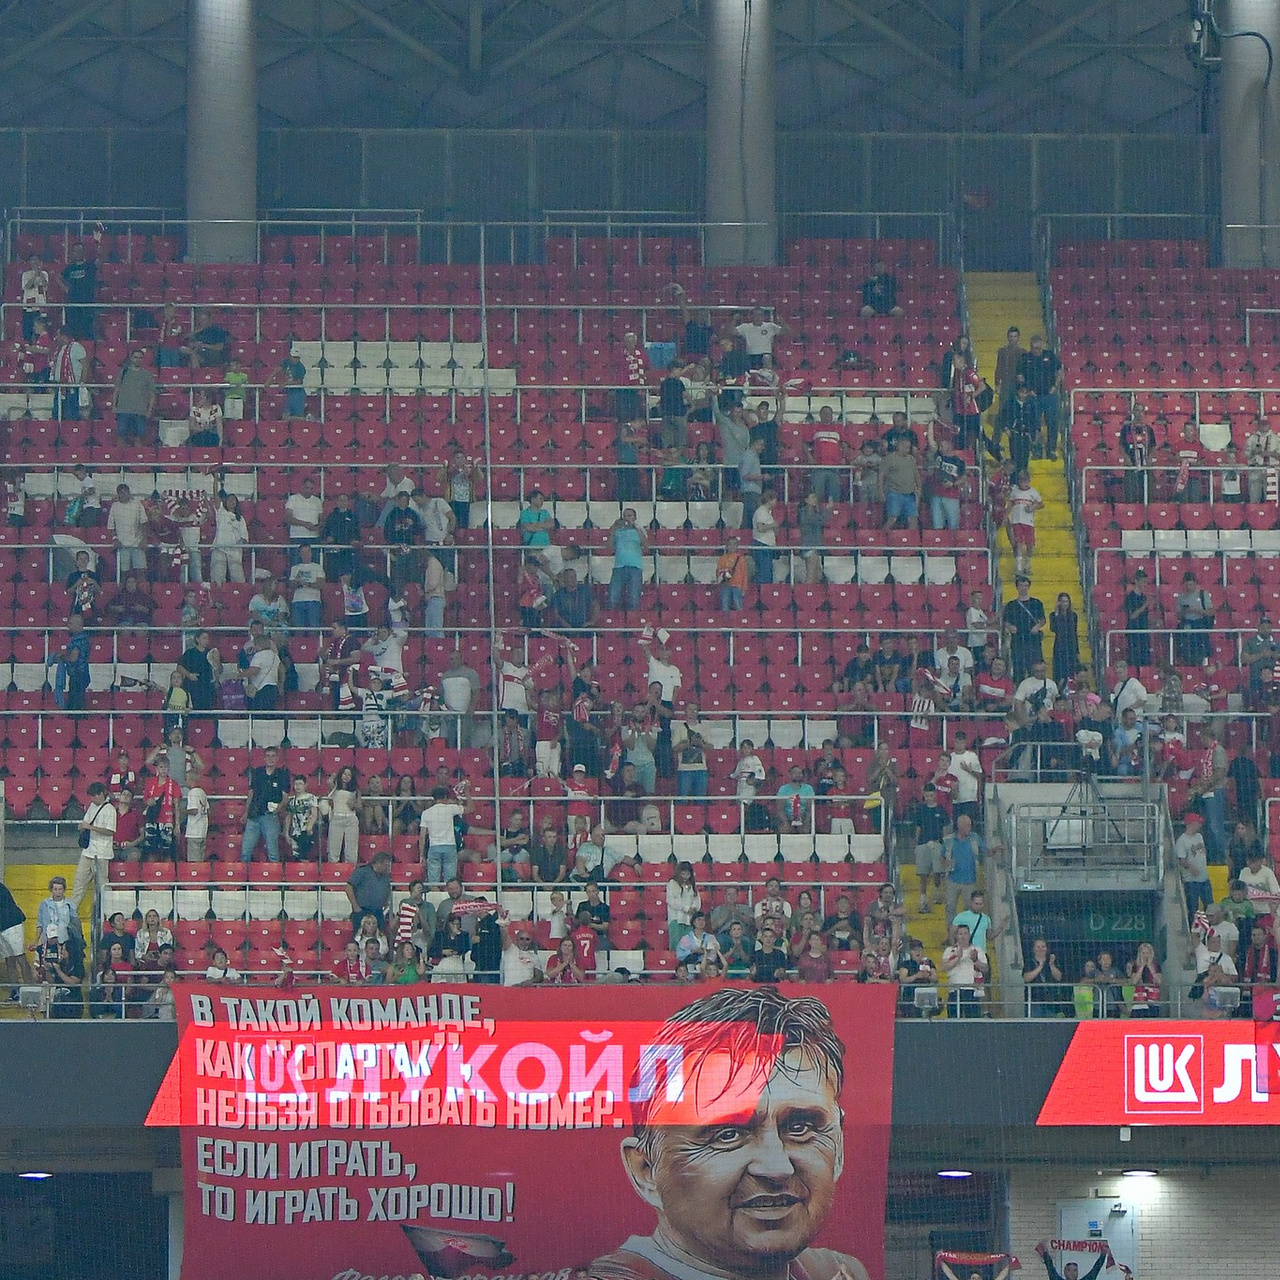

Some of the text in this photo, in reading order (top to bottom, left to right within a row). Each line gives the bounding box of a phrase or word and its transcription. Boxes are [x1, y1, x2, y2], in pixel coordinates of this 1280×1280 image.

[1112, 913, 1146, 931] 228
[190, 993, 496, 1037] В ТАКОЙ КОМАНДЕ,
[196, 1038, 254, 1081] КАК
[196, 1086, 623, 1131] НЕЛЬЗЯ ОТБЫВАТЬ НОМЕР.
[197, 1136, 416, 1182] ЕСЛИ ИГРАТЬ,
[197, 1181, 515, 1225] ТО ИГРАТЬ ХОРОШО!
